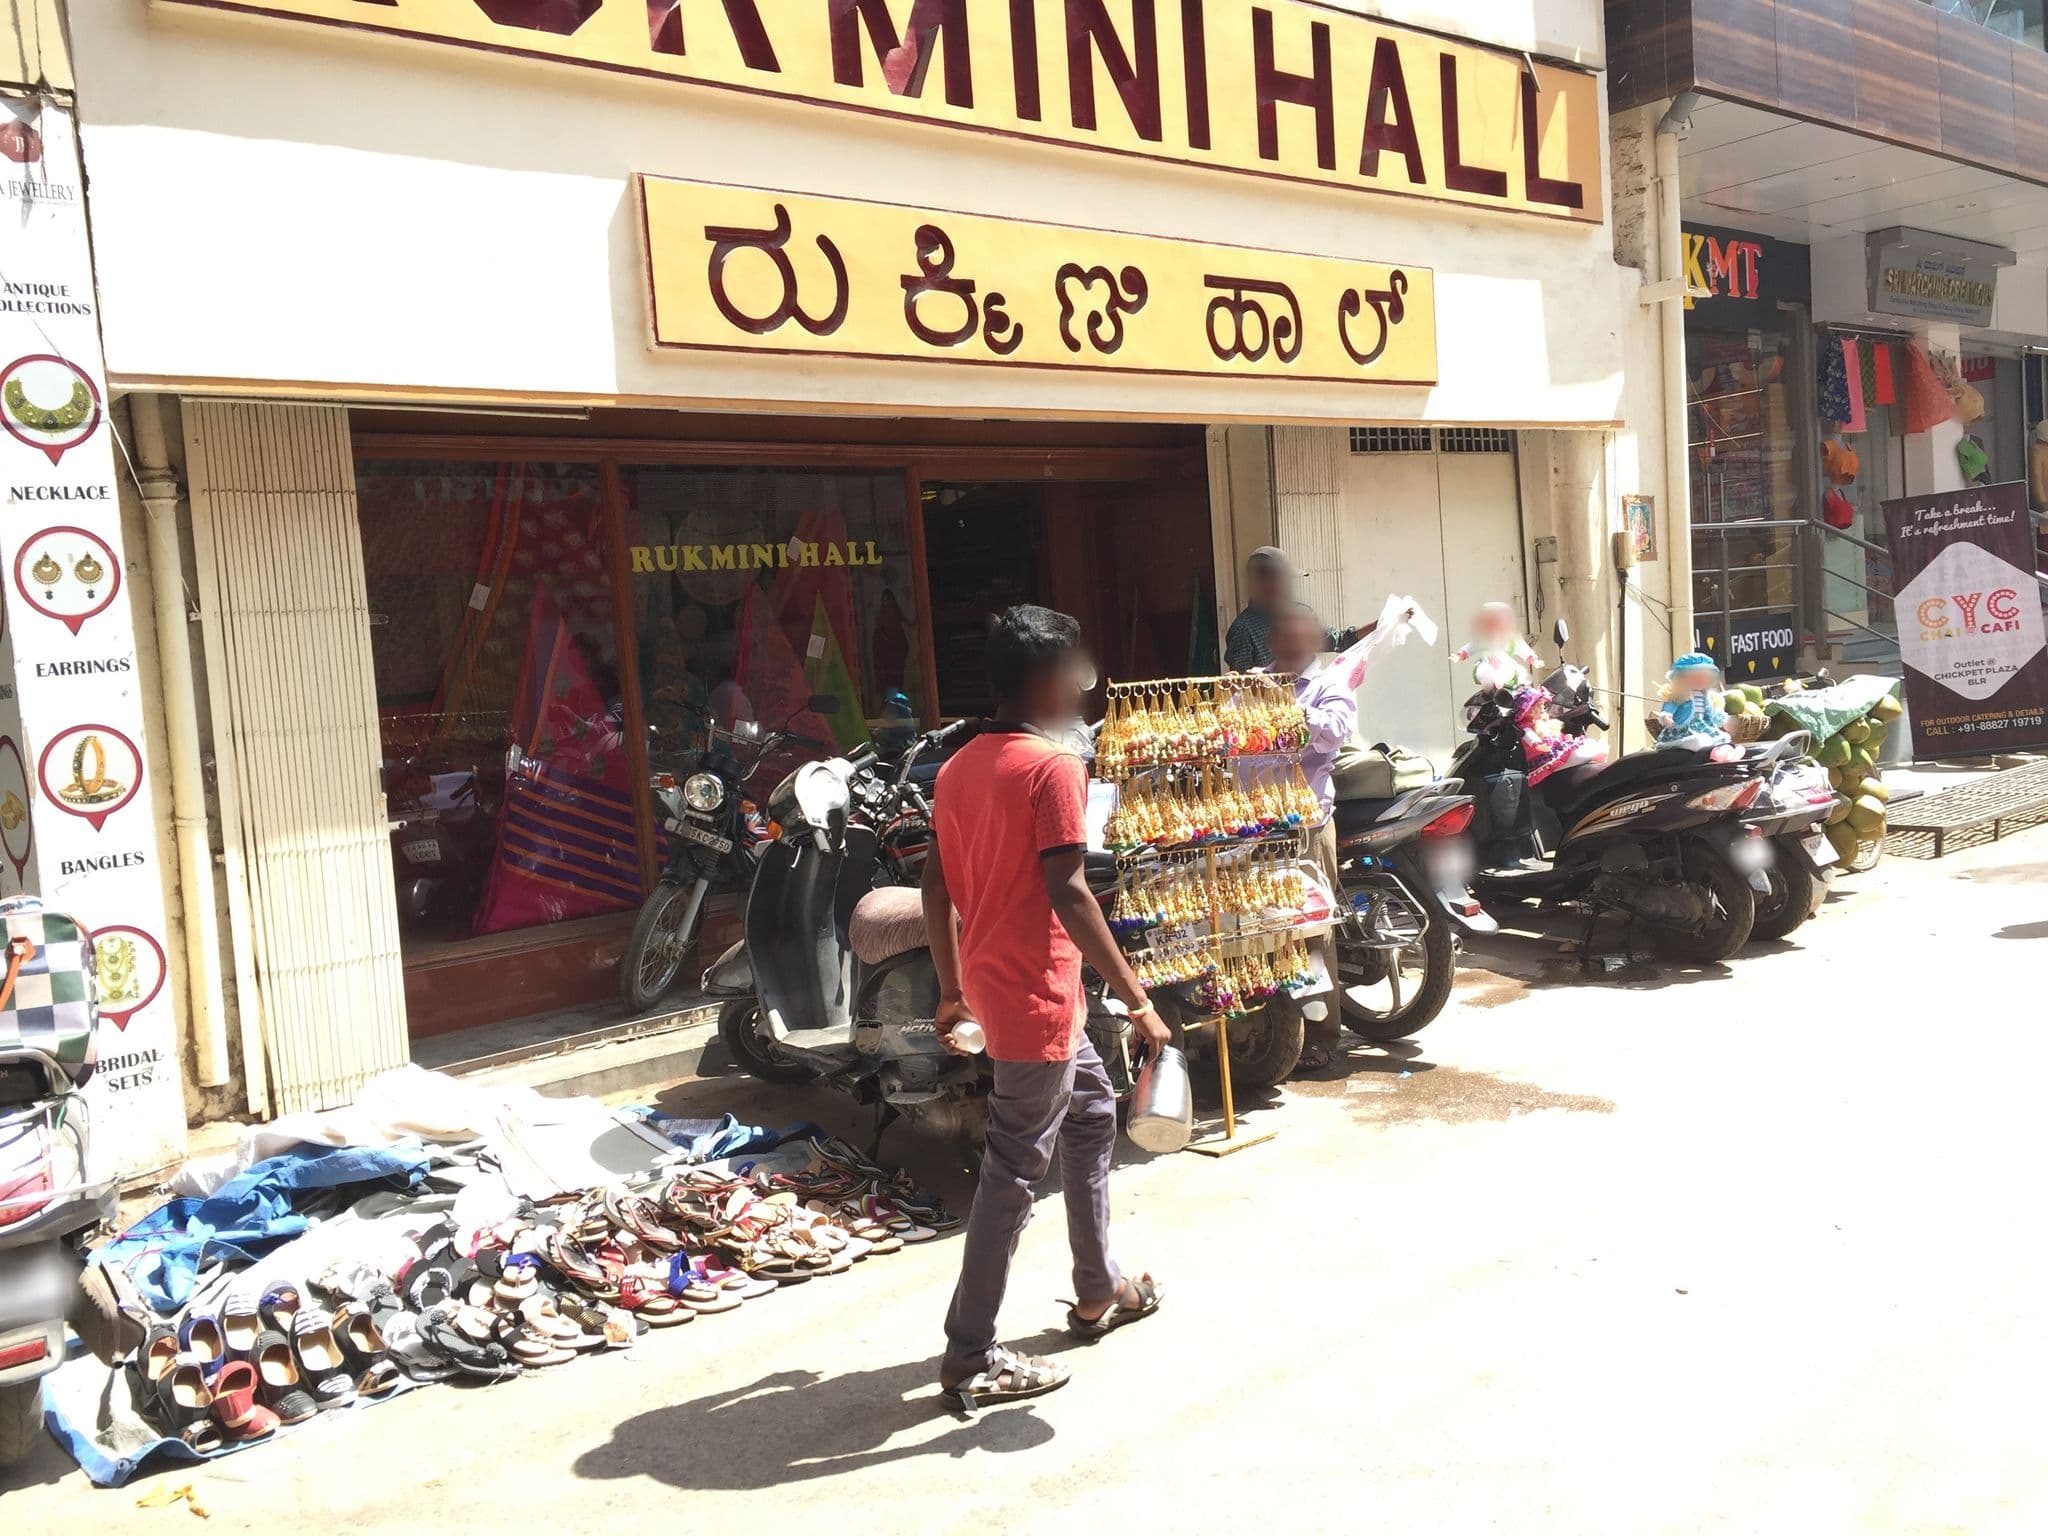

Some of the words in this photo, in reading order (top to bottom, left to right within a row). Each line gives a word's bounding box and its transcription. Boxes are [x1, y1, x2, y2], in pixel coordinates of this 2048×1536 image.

[1252, 6, 1584, 209] HALL
[8, 180, 74, 200] JEWELLERY
[4, 282, 70, 298] ANTIQUE
[1203, 269, 1408, 365] ಹಾಲ್
[10, 485, 110, 501] NECKLACE
[1901, 525, 1922, 538] It's
[1923, 515, 1985, 536] refreshment
[1987, 510, 2016, 526] time!
[1915, 507, 1942, 521] Take
[630, 543, 789, 573] RUKMINI
[799, 541, 883, 567] HALL
[1917, 588, 2020, 632] CYC
[1731, 632, 1760, 654] FAST
[1762, 628, 1794, 650] FOOD
[36, 658, 131, 677] EARRINGS
[1934, 669, 1983, 680] CHICKPET
[1985, 664, 2018, 674] PLAZA
[1953, 659, 1985, 669] Outlet
[1967, 677, 1987, 686] BLR
[1921, 719, 1935, 728] FOR
[1936, 715, 1970, 725] OUTDOOR
[1971, 711, 2006, 721] CATERING
[2015, 707, 2045, 716] DETAILS
[1926, 726, 1949, 737] CALL
[1957, 719, 2009, 733] +91-88827
[2012, 716, 2041, 727] 19719
[61, 851, 145, 875] BANGLES
[96, 1049, 162, 1074] BRIDAL
[108, 1072, 153, 1093] SETS
